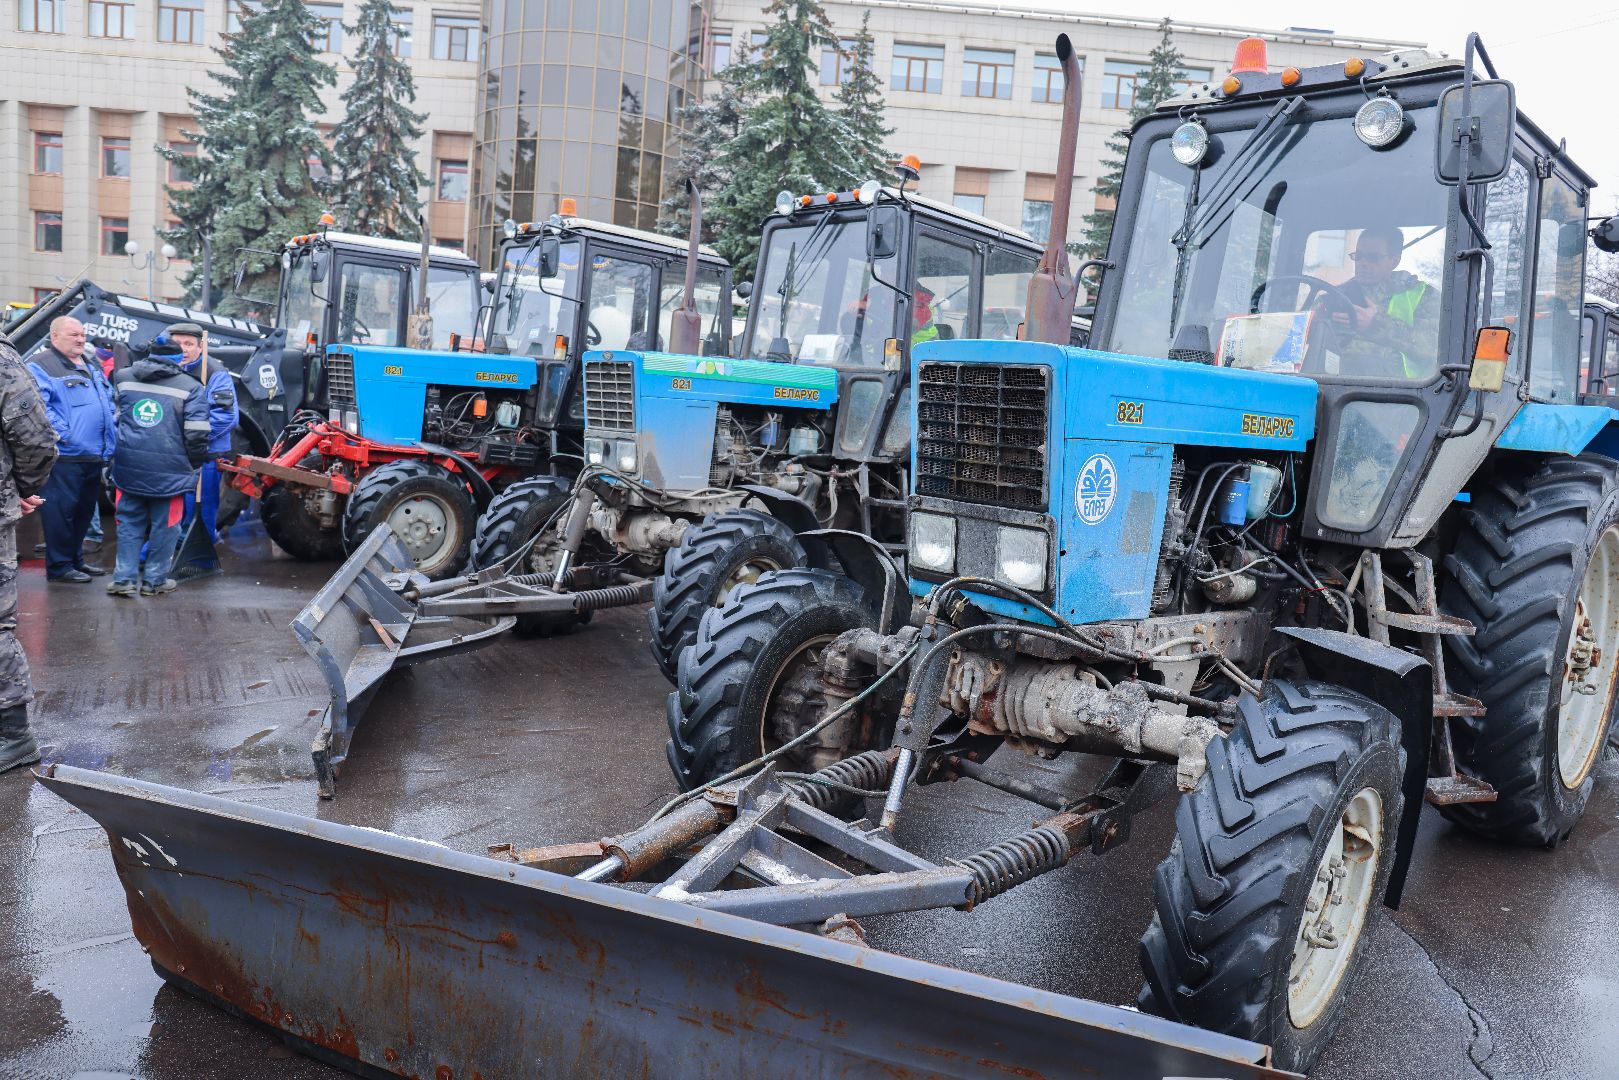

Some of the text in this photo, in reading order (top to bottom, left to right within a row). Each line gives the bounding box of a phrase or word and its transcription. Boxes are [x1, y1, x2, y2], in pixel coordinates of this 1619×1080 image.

[100, 312, 139, 332] TURS
[83, 322, 131, 343] 1500M
[475, 371, 518, 382] БЕЛАРУС
[672, 378, 692, 390] 82.1
[773, 387, 820, 401] БЕЛАРУС
[1116, 401, 1145, 425] 82.1
[1241, 413, 1295, 438] БЕЛАРУС
